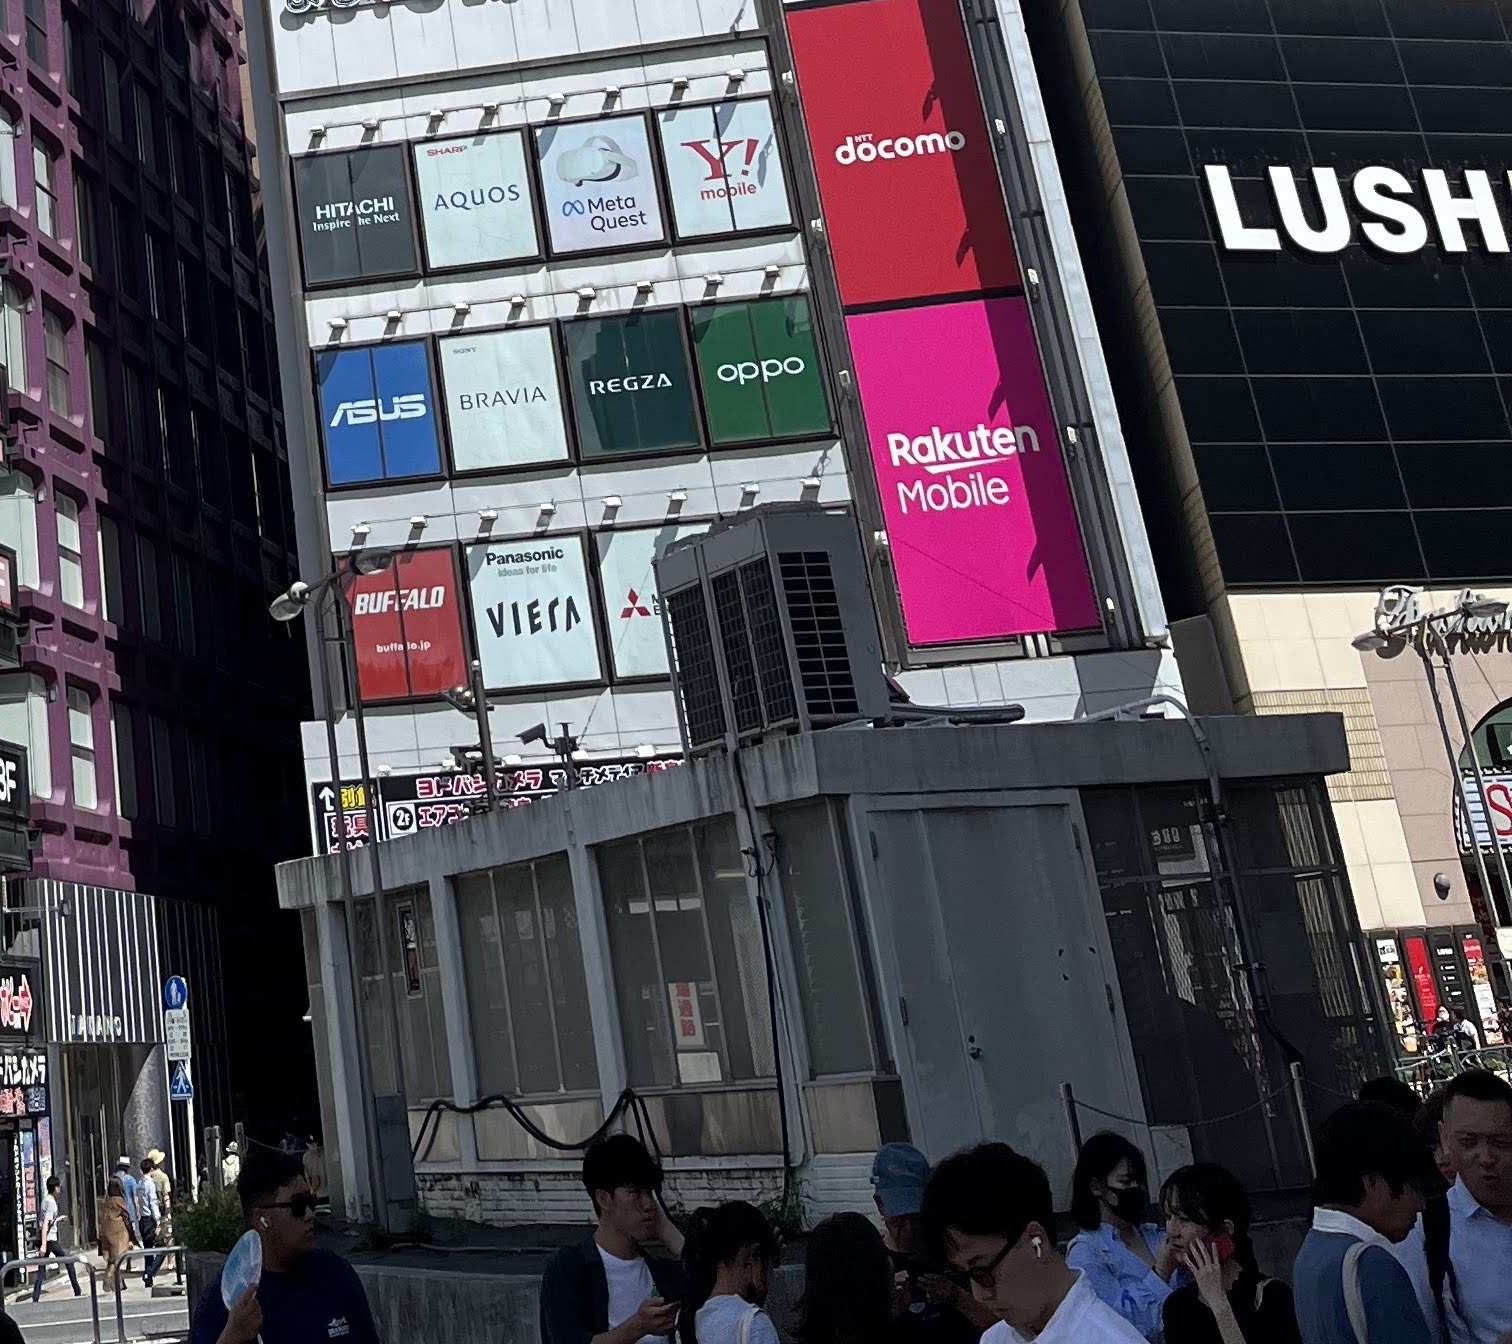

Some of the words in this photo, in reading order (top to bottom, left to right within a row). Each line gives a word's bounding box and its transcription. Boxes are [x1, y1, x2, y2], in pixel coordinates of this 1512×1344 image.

[426, 144, 467, 157] SHARP
[835, 128, 966, 165] docomo
[854, 132, 874, 143] NTT
[681, 139, 759, 182] Y!
[434, 184, 520, 212] AQUOS
[587, 193, 637, 213] Meta
[700, 181, 757, 202] mobile
[312, 216, 351, 231] Inspire
[375, 211, 400, 224] Next
[315, 196, 395, 220] HITACHI
[1203, 164, 1510, 253] LUSH
[590, 210, 647, 234] Quest
[716, 355, 806, 386] oppo
[589, 372, 673, 396] REGZA
[330, 393, 427, 427] ASUS
[459, 385, 546, 411] BRAVIA
[887, 424, 1041, 468] Rakuten
[897, 472, 1009, 514] Mobile
[486, 546, 564, 566] Panasonic
[354, 585, 445, 615] BUFFALO
